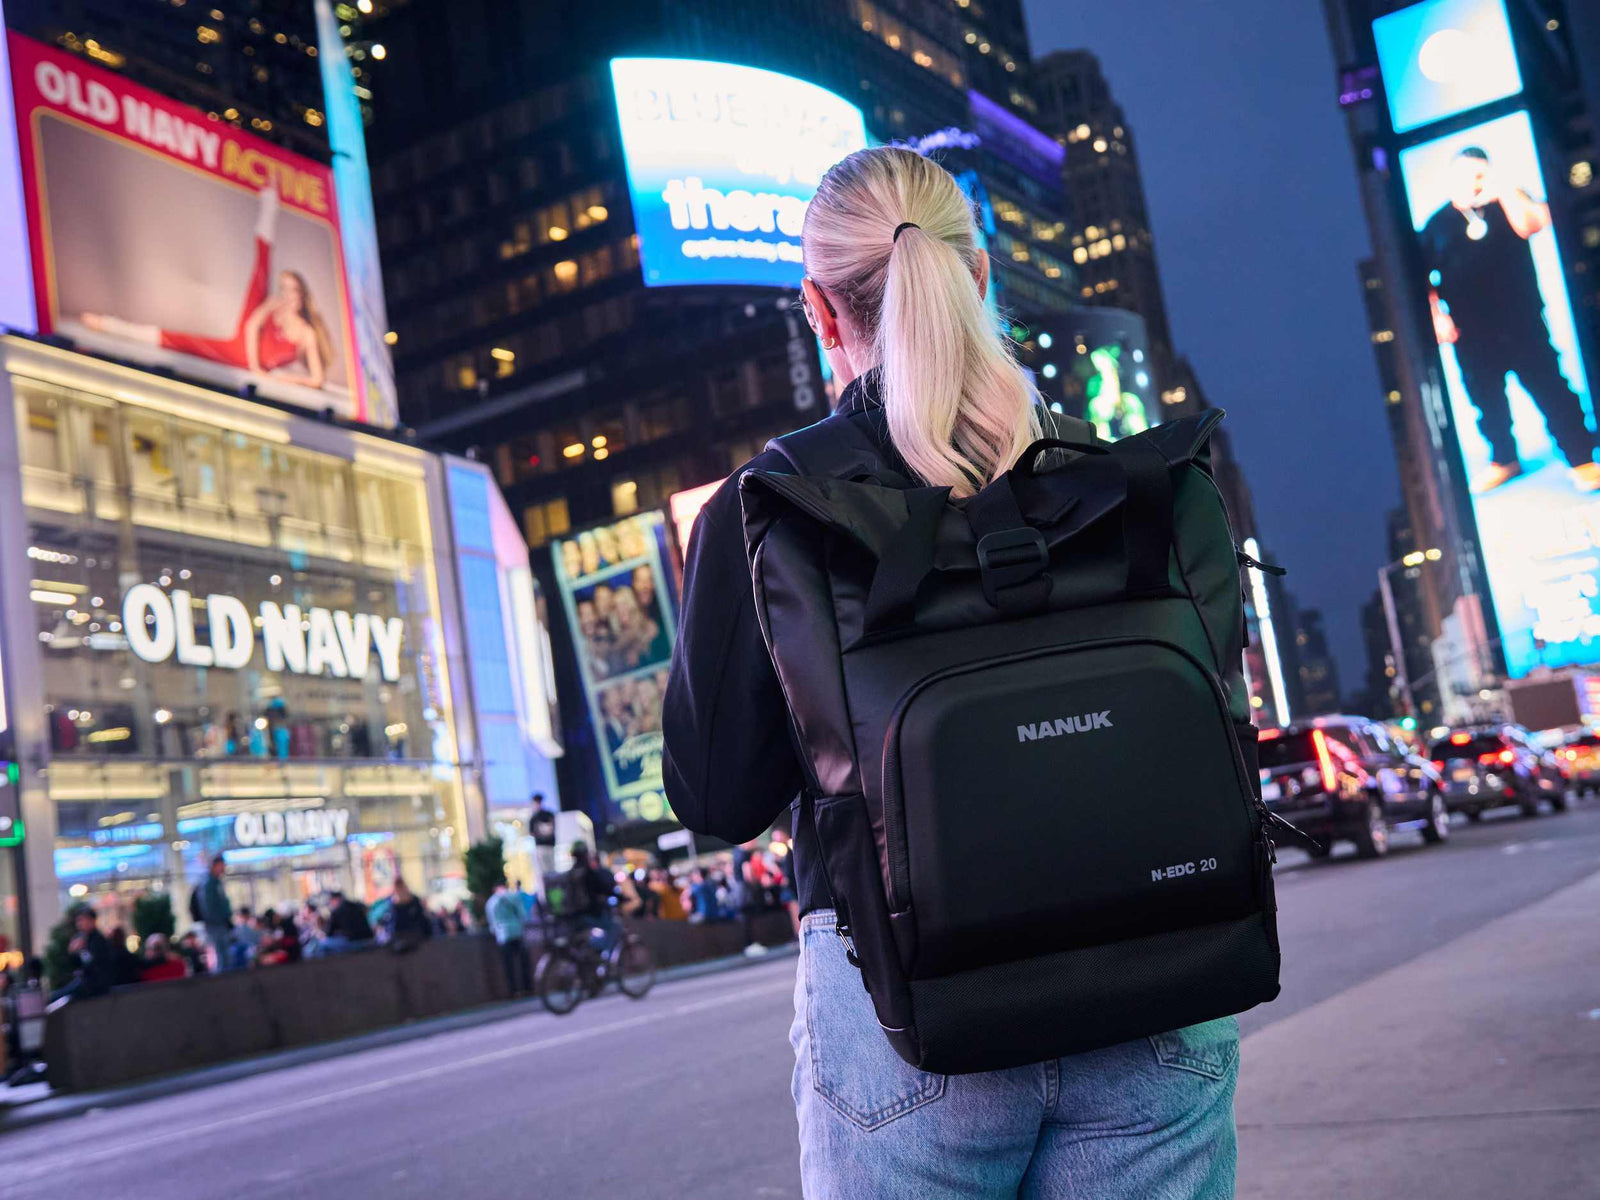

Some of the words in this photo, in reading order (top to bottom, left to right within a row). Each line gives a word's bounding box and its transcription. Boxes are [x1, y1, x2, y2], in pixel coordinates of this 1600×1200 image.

[35, 61, 119, 125] OLD
[124, 95, 221, 169] NAVY
[123, 583, 254, 669] OLD
[260, 600, 403, 682] NAVY
[1017, 710, 1113, 743] NANUK
[234, 811, 285, 847] OLD
[286, 808, 349, 843] NAVY
[1151, 861, 1196, 882] N-EDC
[1201, 857, 1217, 872] 20
